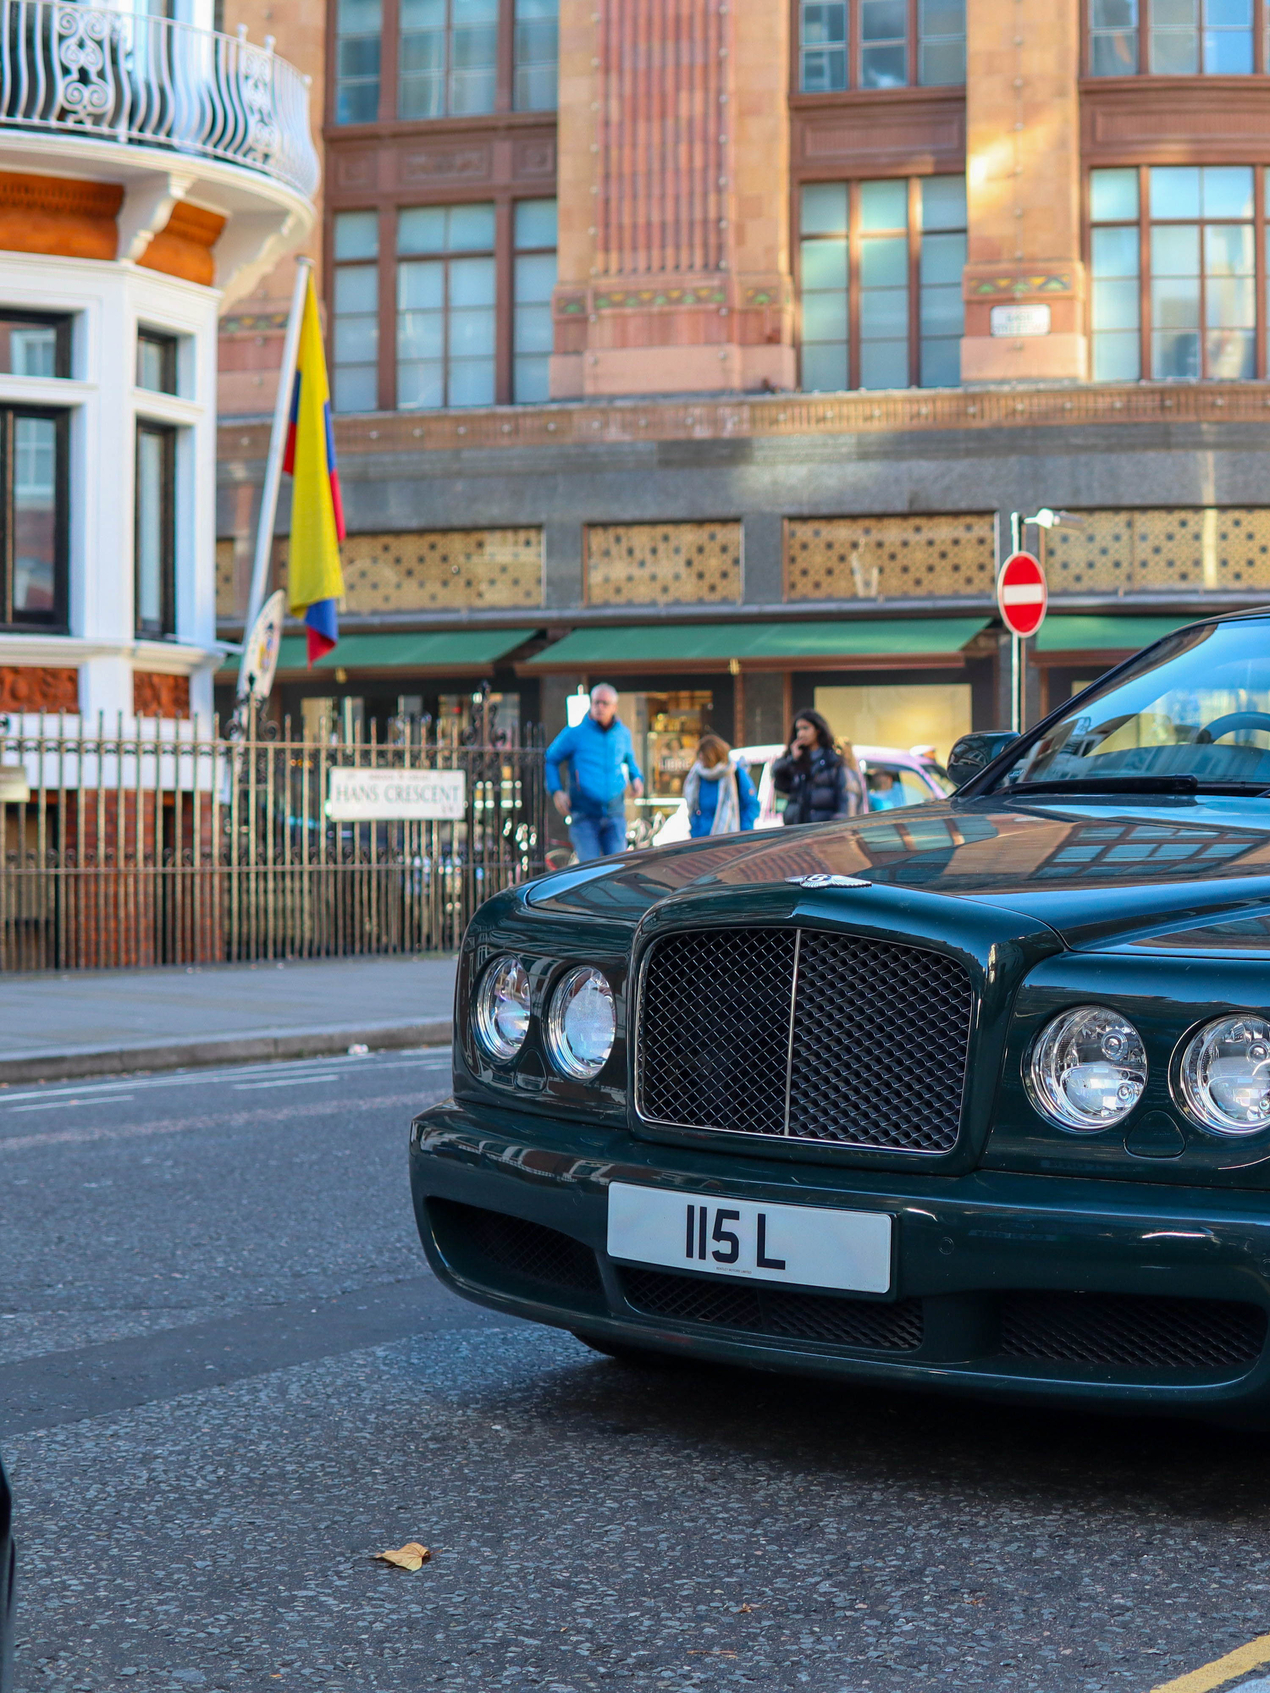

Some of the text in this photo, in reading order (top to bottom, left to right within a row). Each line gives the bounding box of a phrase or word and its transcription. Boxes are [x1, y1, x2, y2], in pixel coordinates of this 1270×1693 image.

[335, 783, 460, 804] HANS CRESCENT
[685, 1204, 786, 1270] 115 L
